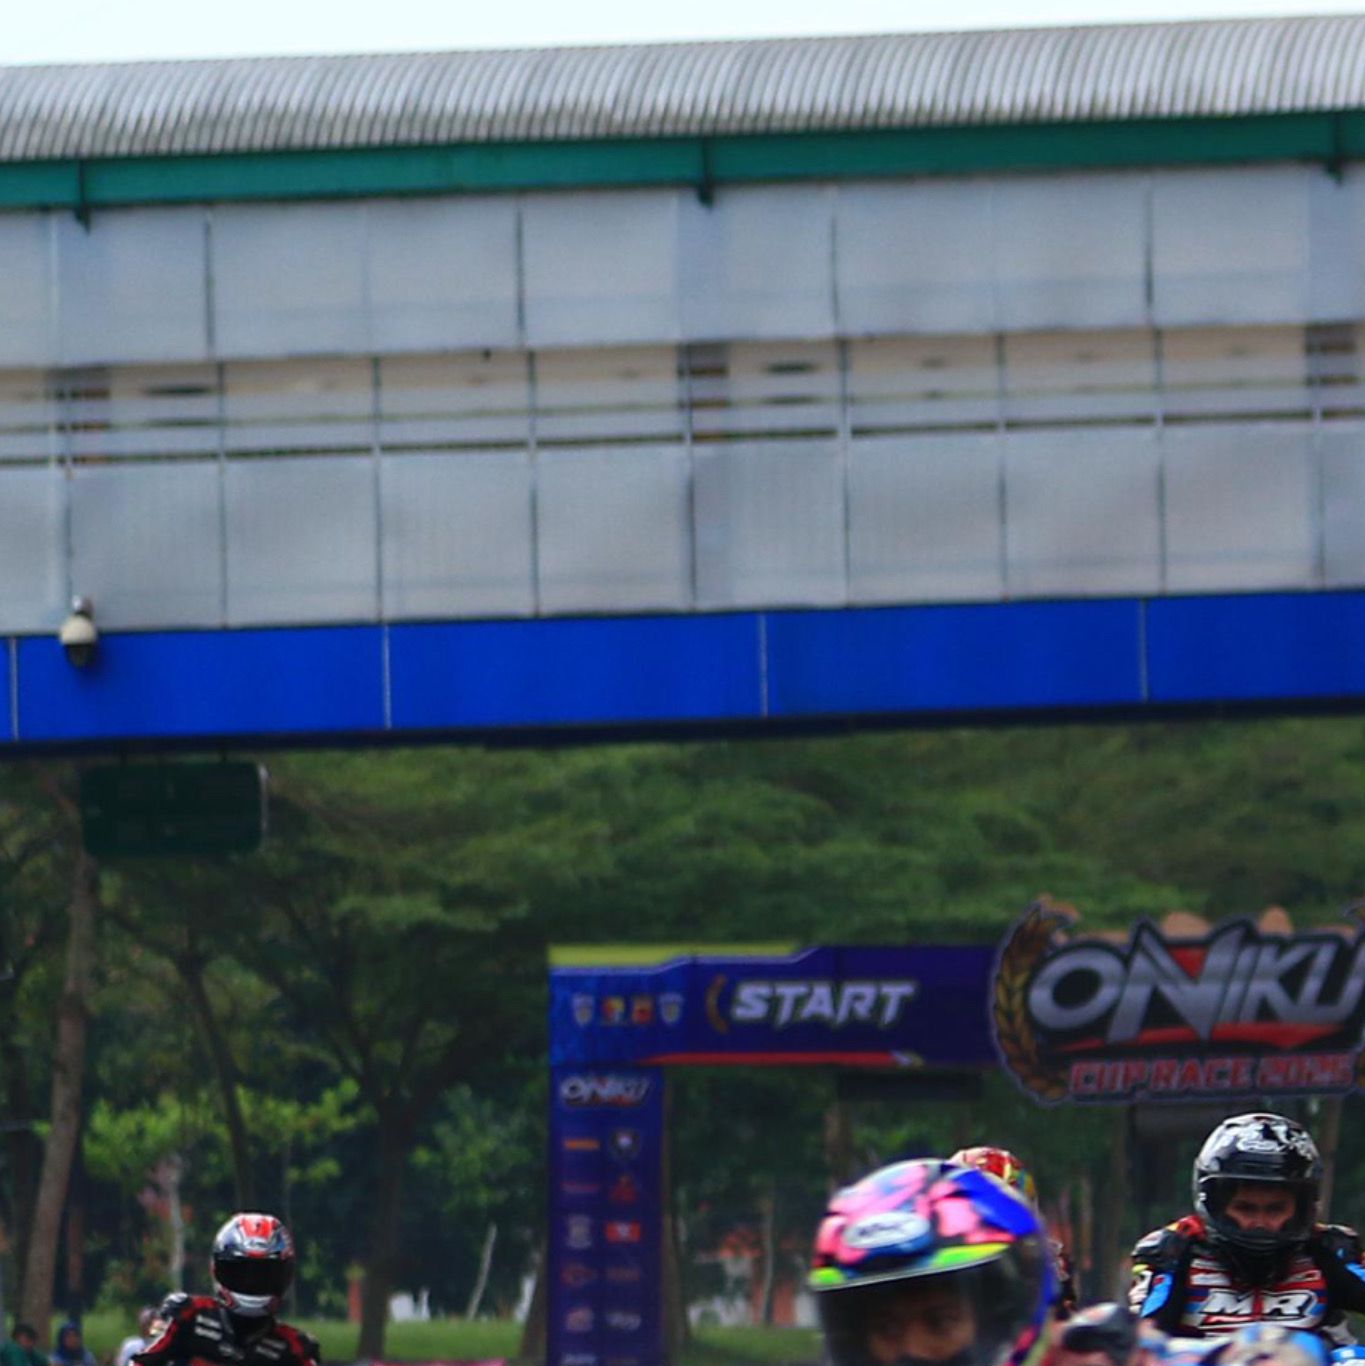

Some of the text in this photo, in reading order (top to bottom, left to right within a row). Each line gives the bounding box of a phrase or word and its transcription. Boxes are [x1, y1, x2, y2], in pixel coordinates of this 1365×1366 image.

[732, 982, 914, 1026] START
[1150, 1057, 1252, 1091] RACE
[1200, 1290, 1312, 1316] MR
